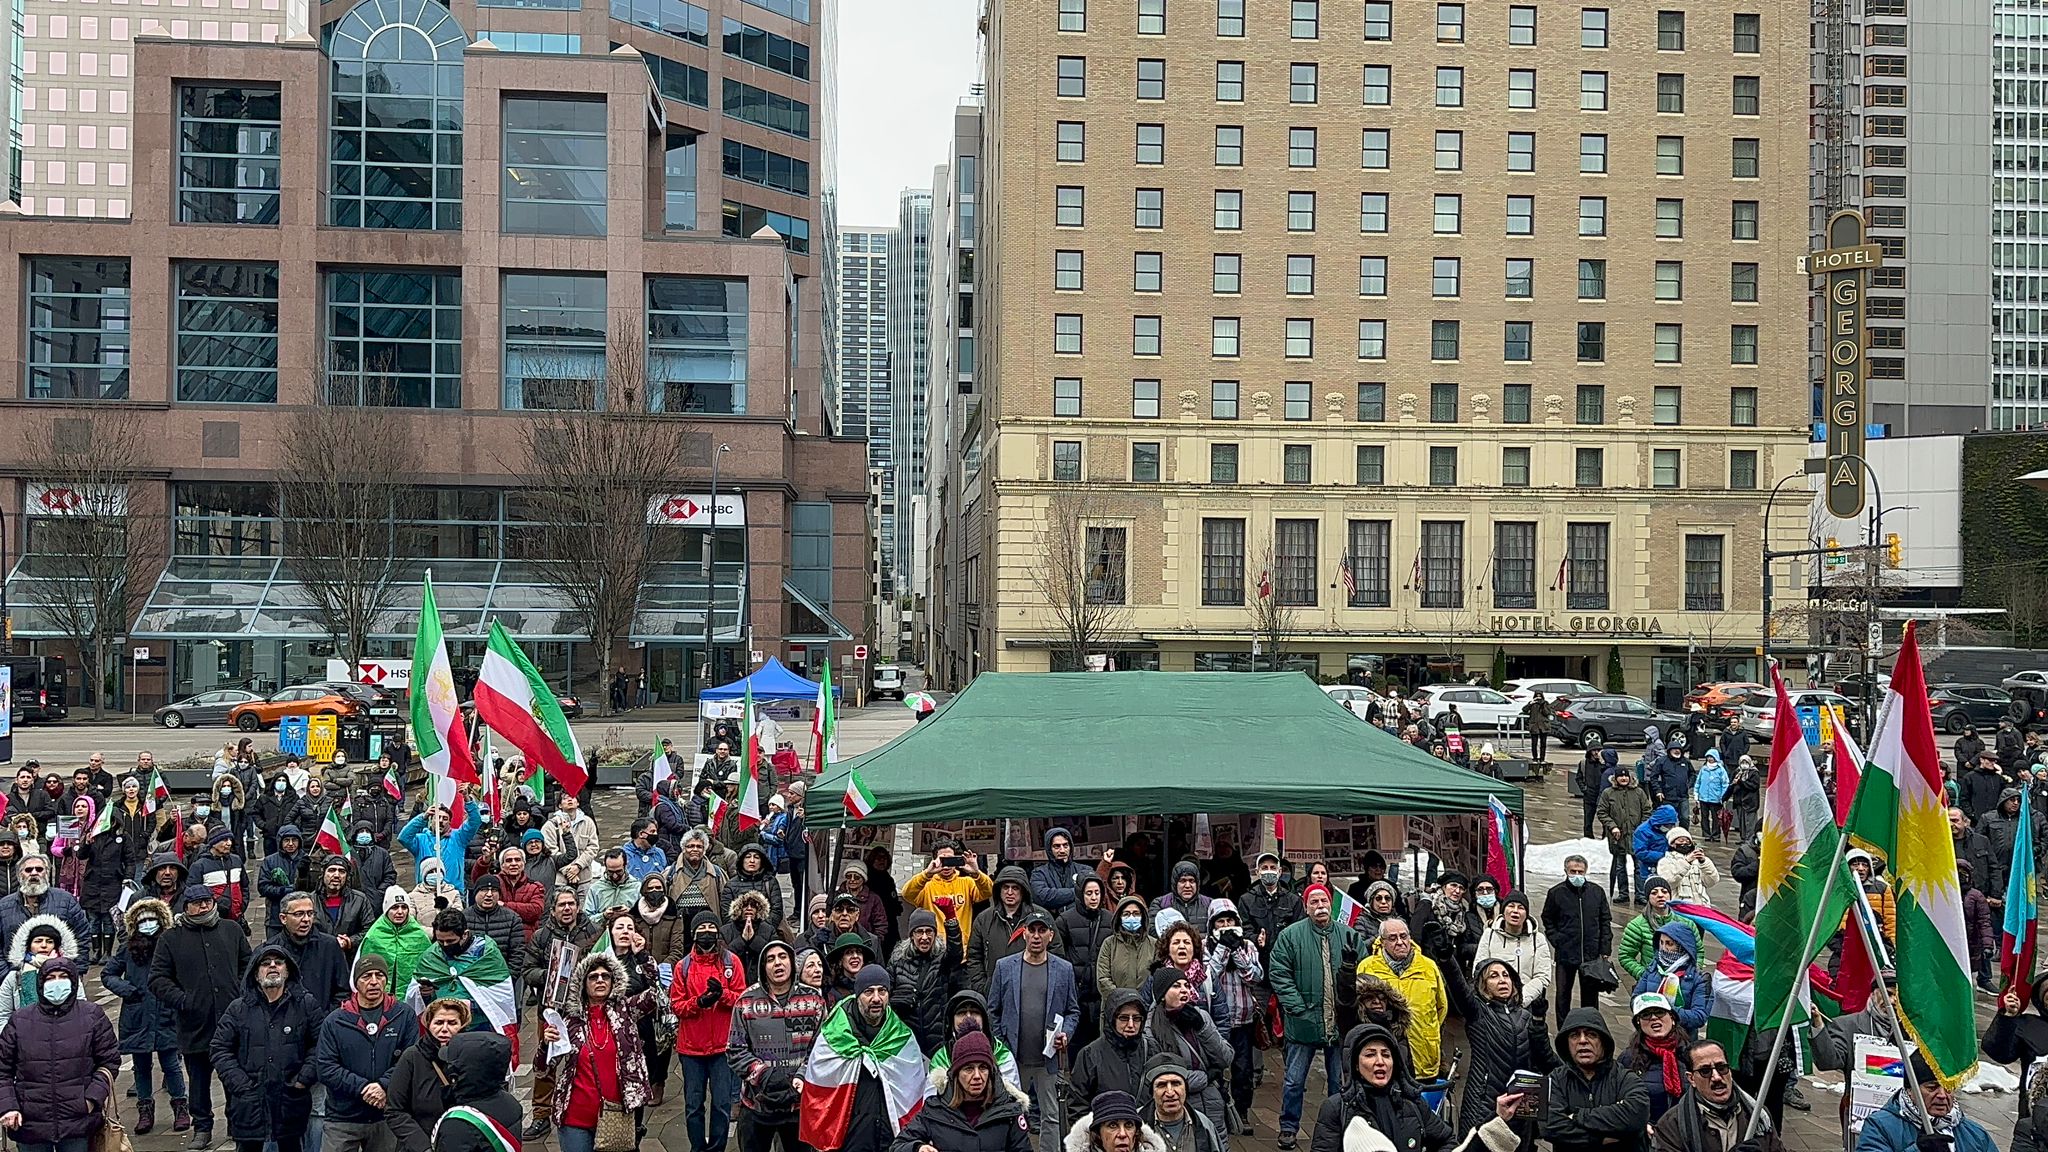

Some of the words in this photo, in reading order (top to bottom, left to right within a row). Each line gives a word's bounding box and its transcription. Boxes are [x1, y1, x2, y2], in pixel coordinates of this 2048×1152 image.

[1816, 250, 1874, 268] HOTEL
[1832, 279, 1858, 486] GEORGIA
[701, 505, 733, 514] HSBC
[1491, 615, 1554, 631] HOTEL
[1570, 616, 1662, 632] GEORGIA
